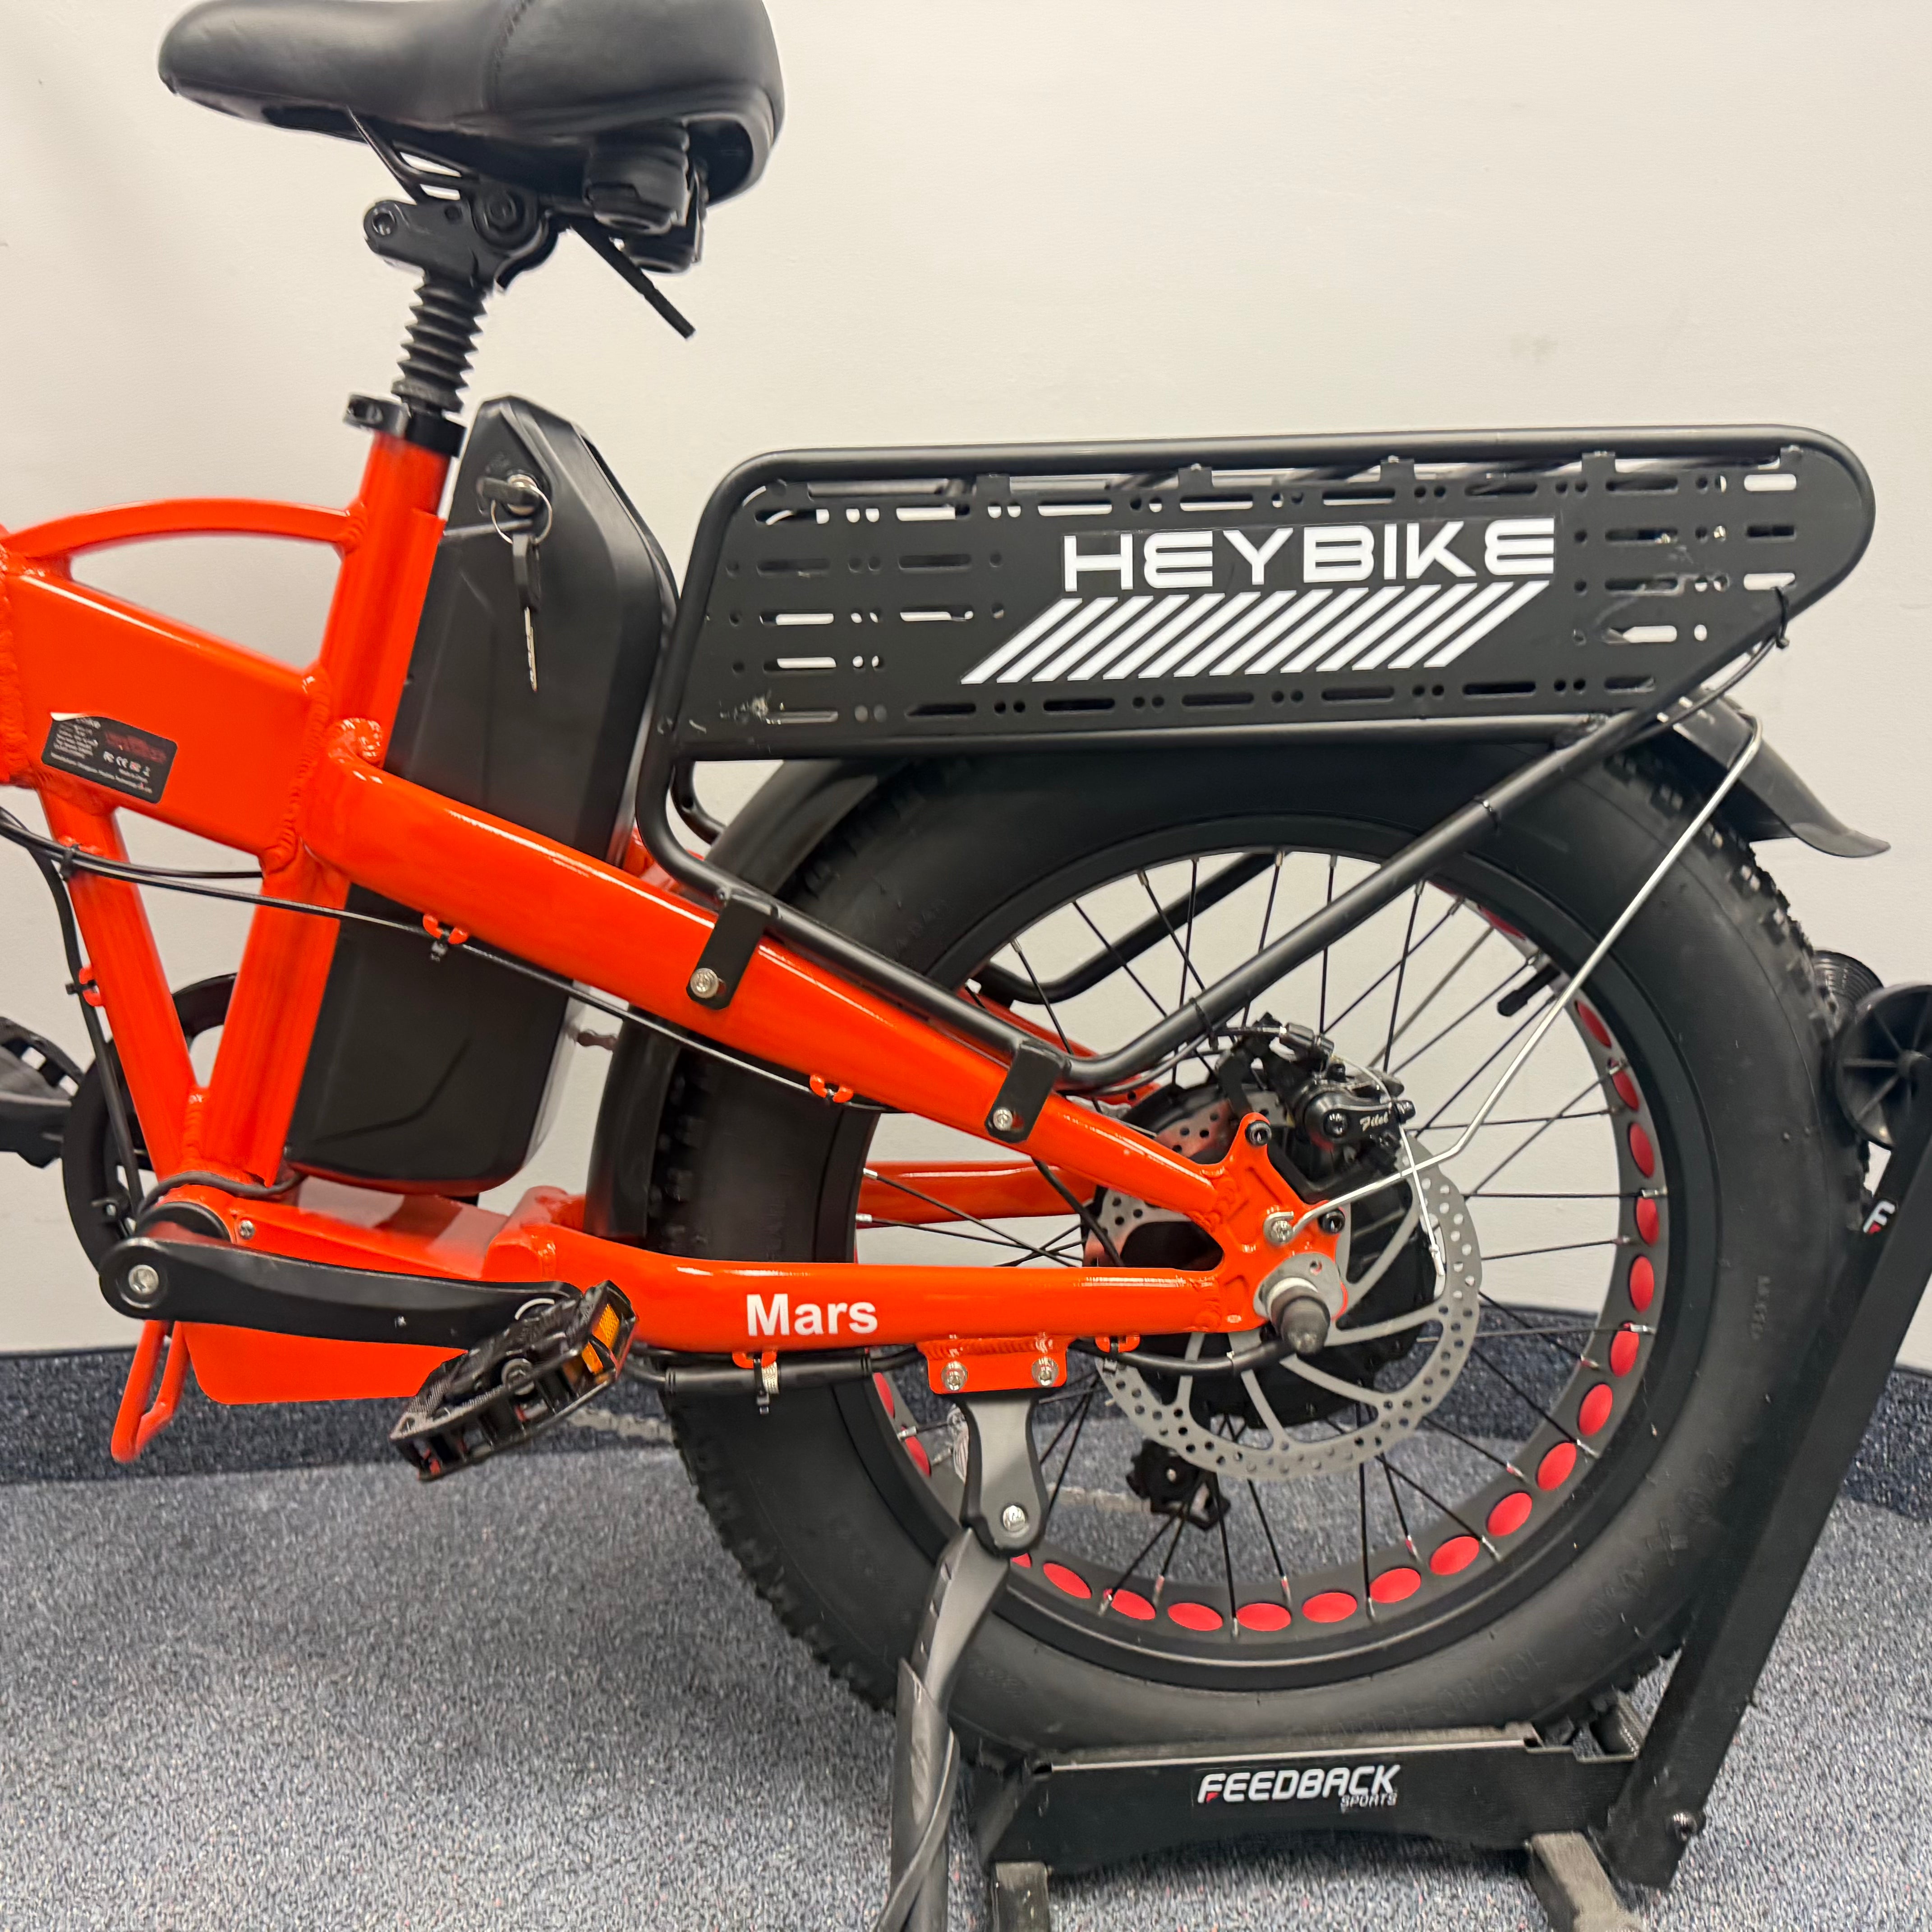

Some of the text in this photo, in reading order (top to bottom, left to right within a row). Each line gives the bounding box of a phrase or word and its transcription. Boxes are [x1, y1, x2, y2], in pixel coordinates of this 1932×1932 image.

[1064, 518, 1554, 591] HEYBIKE
[747, 1293, 878, 1336] Mars
[1197, 1765, 1400, 1803] FEEDBACK
